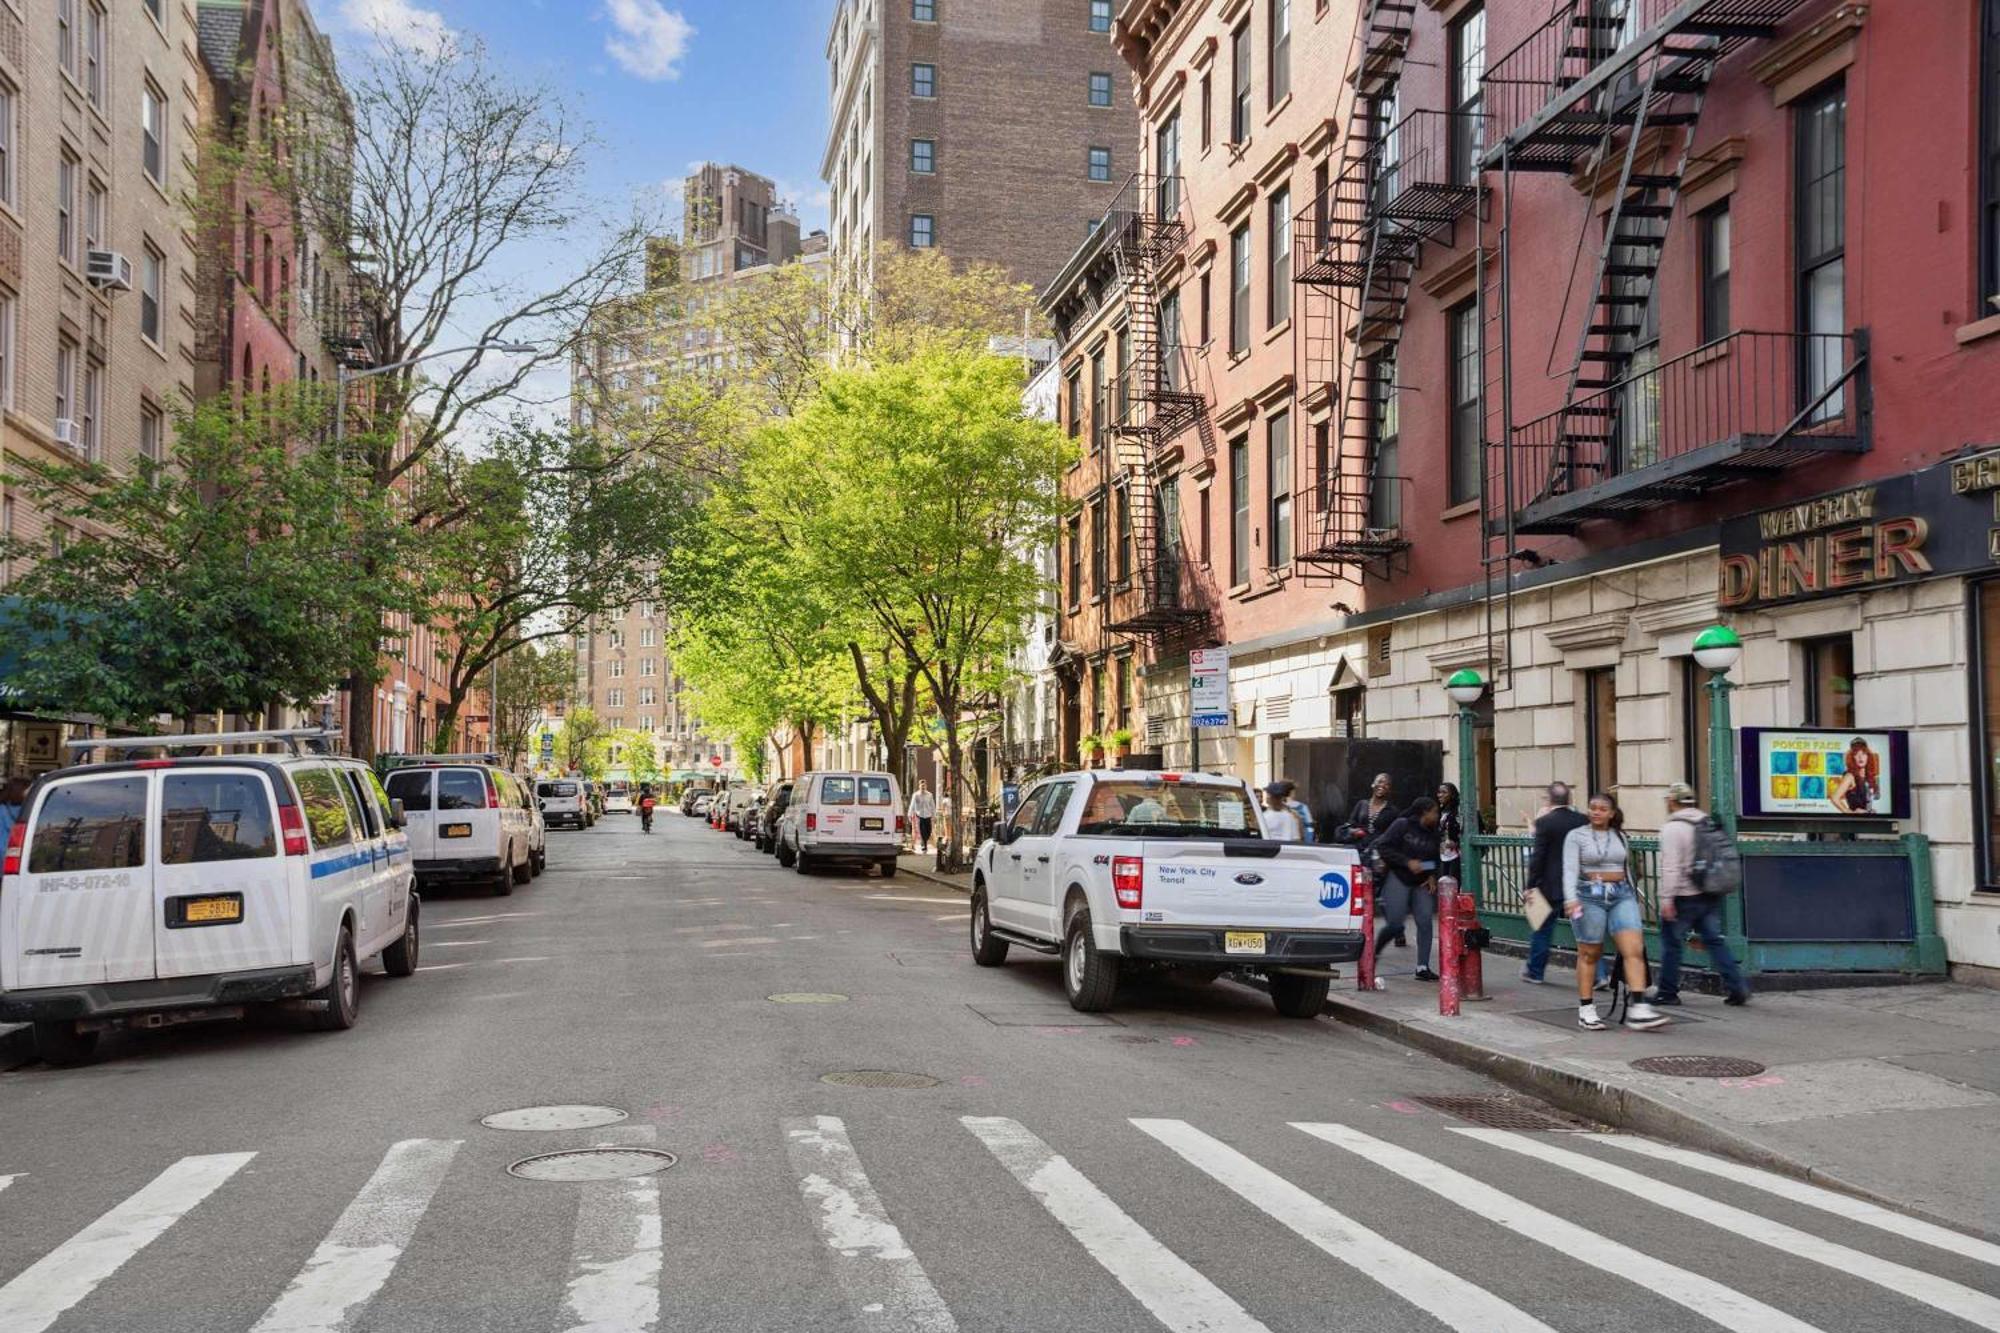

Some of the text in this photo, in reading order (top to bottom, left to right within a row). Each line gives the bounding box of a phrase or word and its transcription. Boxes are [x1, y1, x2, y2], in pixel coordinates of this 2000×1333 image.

[1760, 488, 1875, 538] WAVERLY
[1719, 516, 1933, 607] DINER
[1772, 740, 1842, 750] POKER FACE
[1159, 865, 1216, 878] New York City
[1159, 875, 1185, 885] Transit
[1319, 880, 1344, 901] MTA
